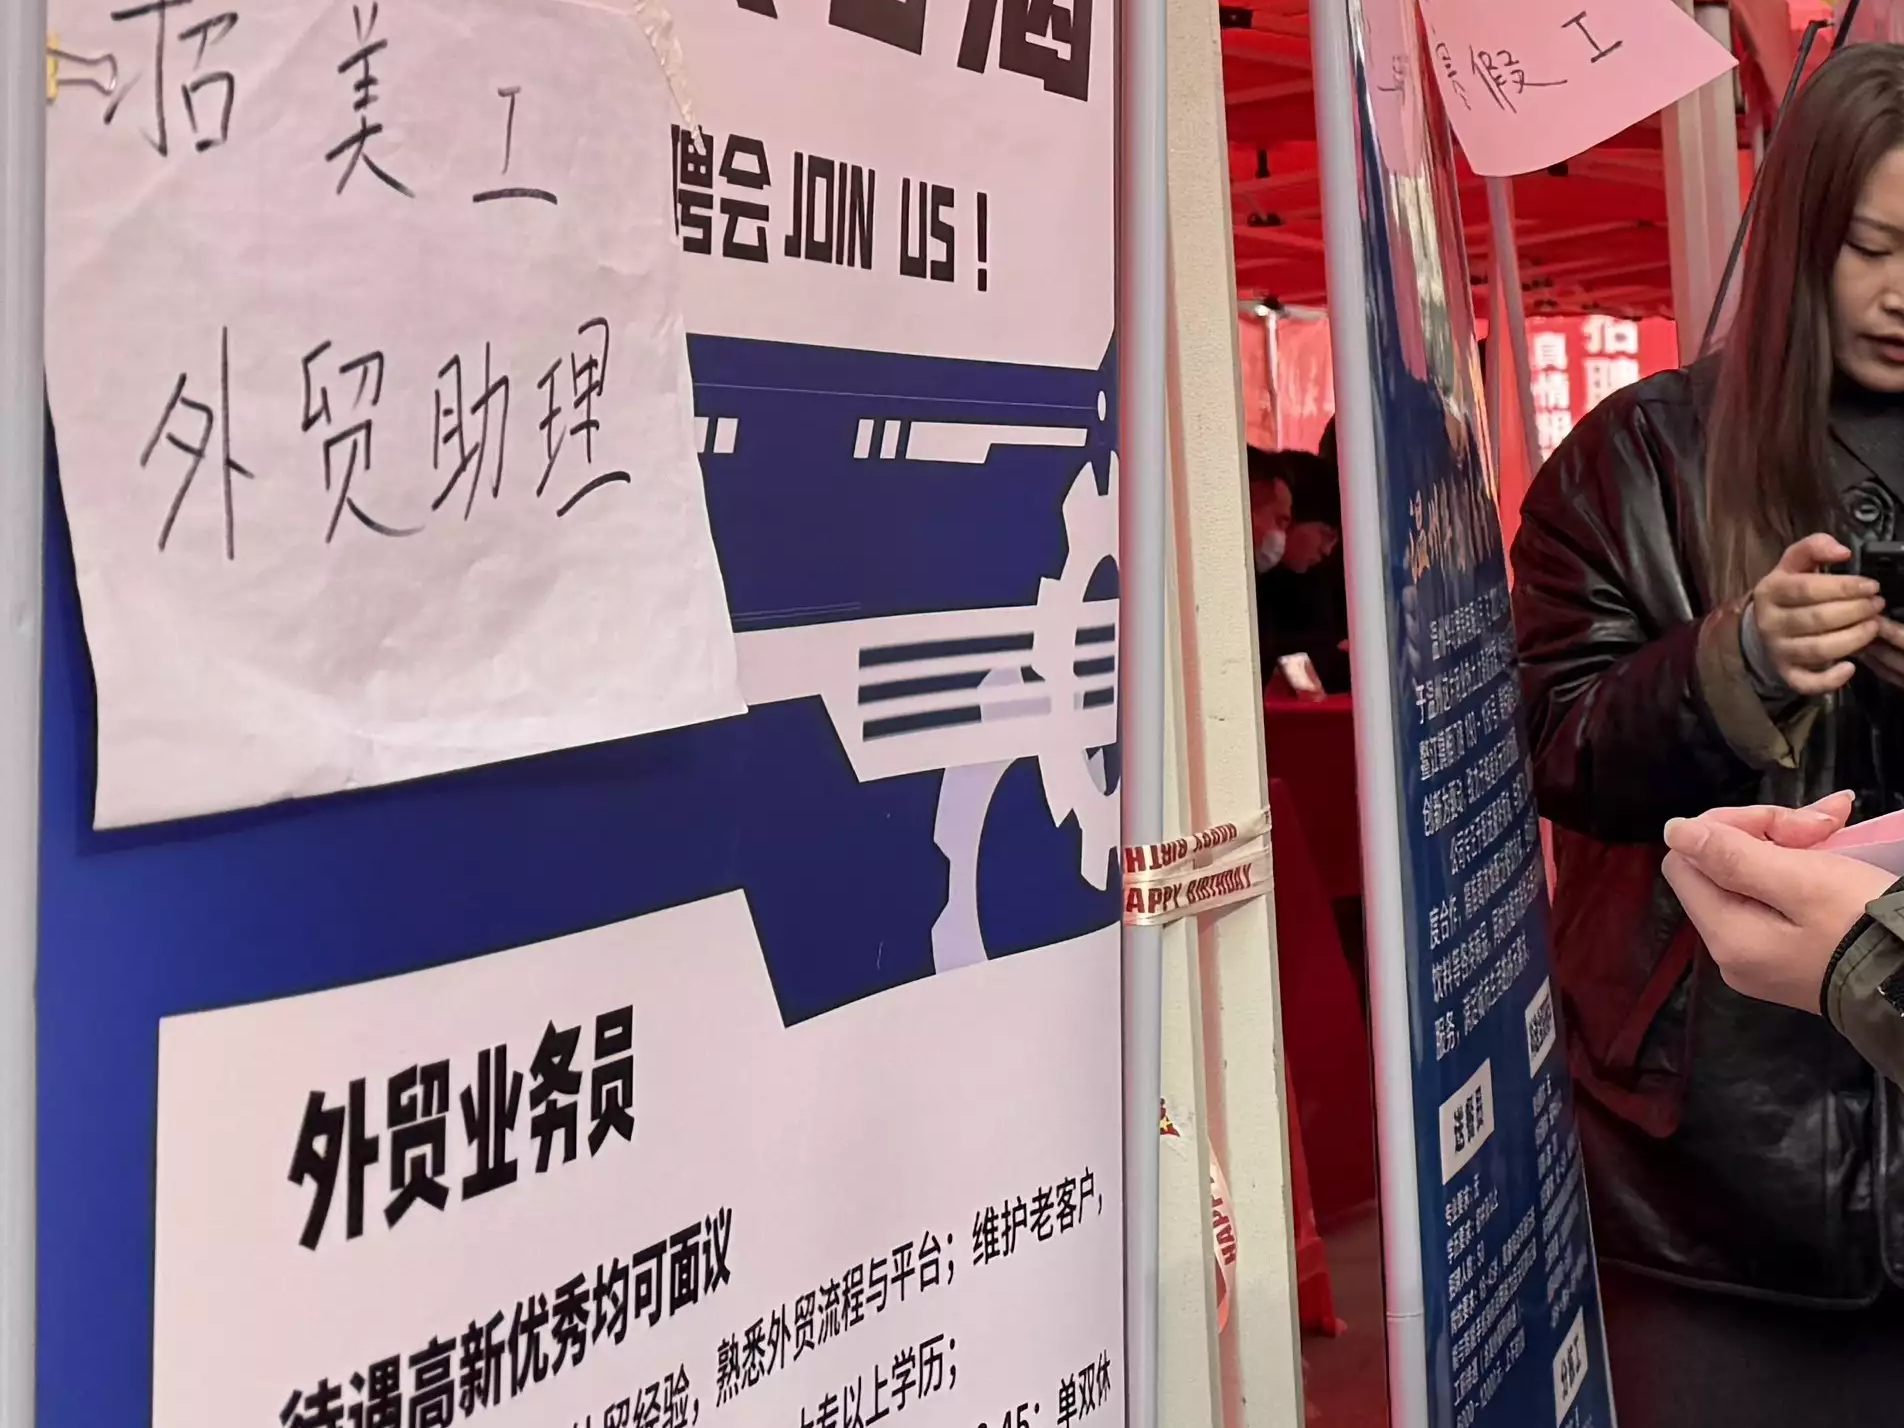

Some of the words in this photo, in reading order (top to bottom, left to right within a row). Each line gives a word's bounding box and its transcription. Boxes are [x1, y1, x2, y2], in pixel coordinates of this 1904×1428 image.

[784, 150, 876, 270] JOIN
[141, 318, 631, 560] 外贸助理
[286, 1006, 636, 1252] 外贸业务员
